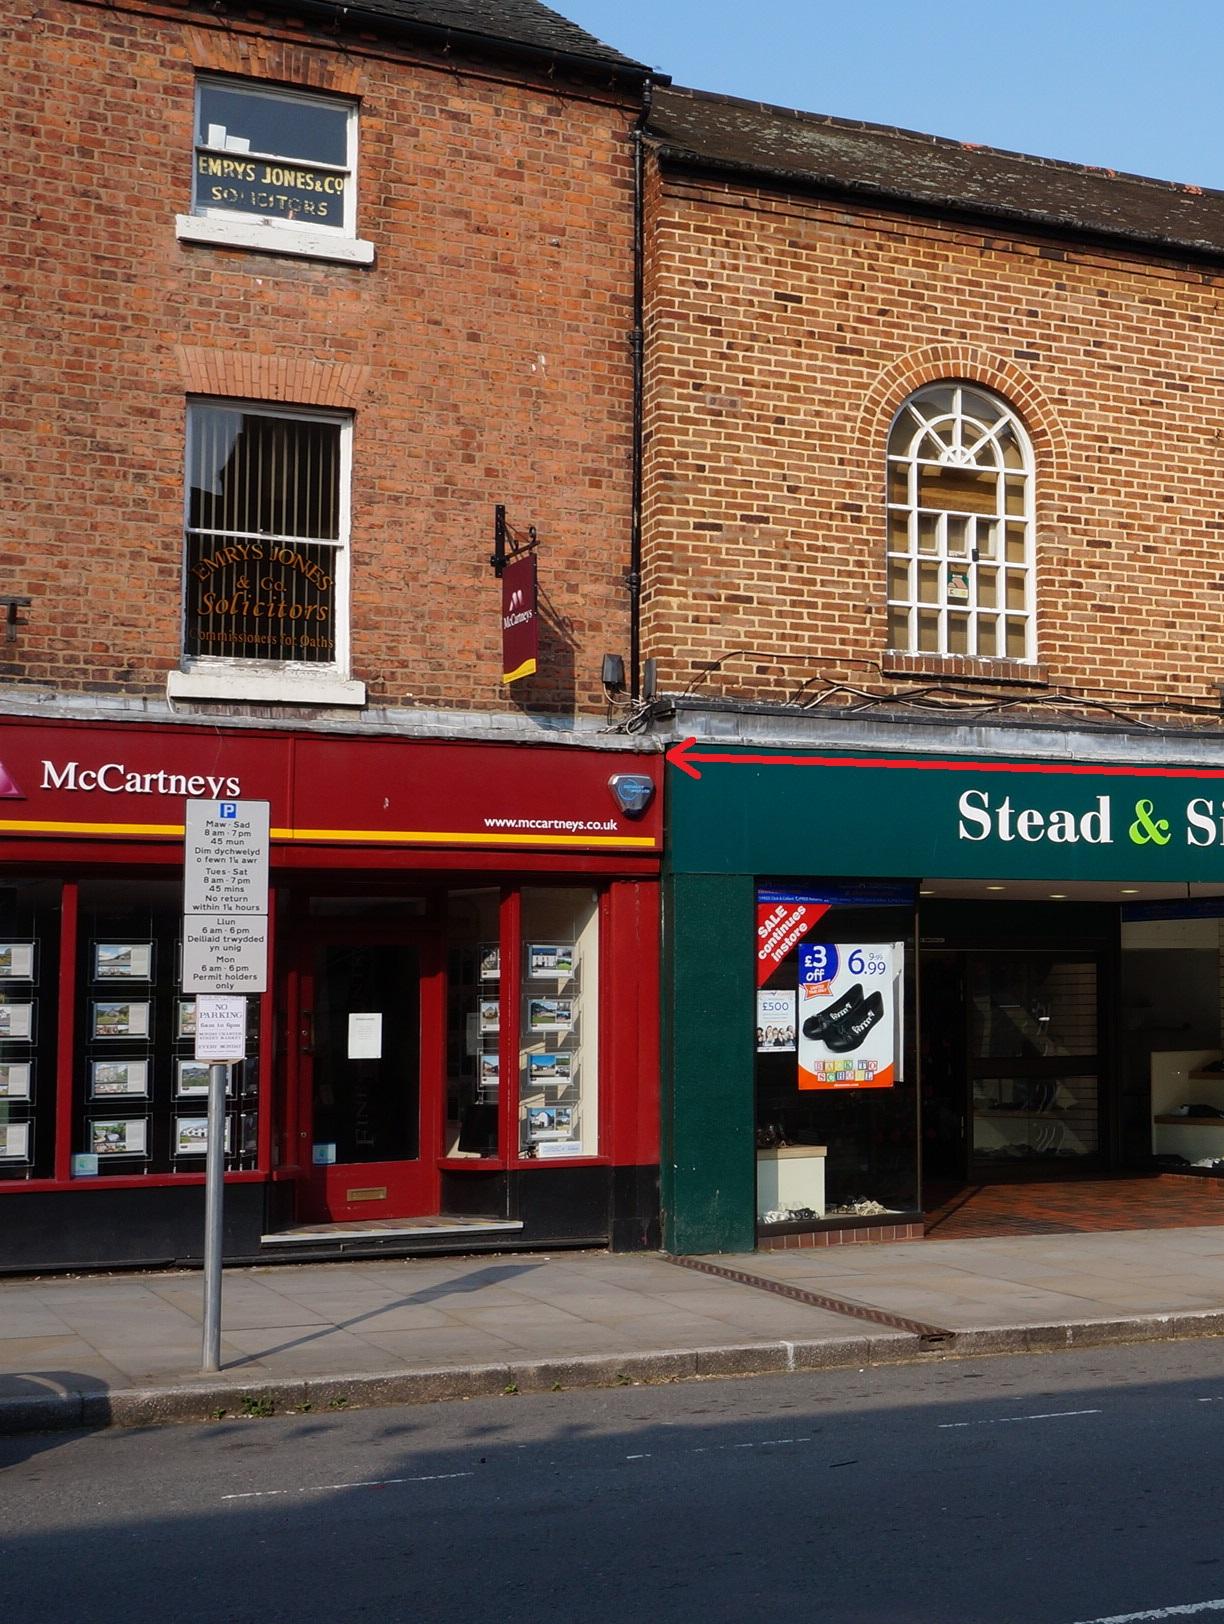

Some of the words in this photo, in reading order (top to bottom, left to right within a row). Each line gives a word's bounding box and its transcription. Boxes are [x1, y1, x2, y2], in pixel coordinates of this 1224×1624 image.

[198, 156, 255, 181] EMRYS
[211, 186, 328, 216] SOICITORS
[192, 543, 264, 581] EMRYS
[270, 546, 335, 590] JONES
[236, 575, 250, 589] &
[196, 592, 328, 621] Solicitors
[503, 608, 532, 629] McCartneys
[190, 629, 277, 645] Commissioners
[280, 632, 297, 646] for
[300, 632, 334, 649] Oaths
[41, 759, 241, 799] McCartneys
[206, 820, 227, 828] Maw
[233, 821, 250, 829] Sad
[484, 816, 618, 833] www.mccartneys.co.uk
[958, 790, 1114, 843] Stead
[1128, 799, 1172, 845] &
[214, 847, 260, 856] dychwelyd
[233, 868, 248, 876] Sat
[758, 905, 788, 938] SALE
[223, 936, 264, 944] trwydded
[758, 905, 807, 960] continues
[222, 944, 242, 952] unig
[771, 922, 808, 962] instore
[804, 945, 827, 968] £3
[848, 949, 886, 975] 6.99
[225, 973, 257, 981] holders
[806, 969, 825, 981] off
[216, 982, 234, 990] only
[762, 1002, 789, 1011] £500
[815, 1060, 852, 1070] BAK
[817, 1071, 874, 1081] SCHOL
